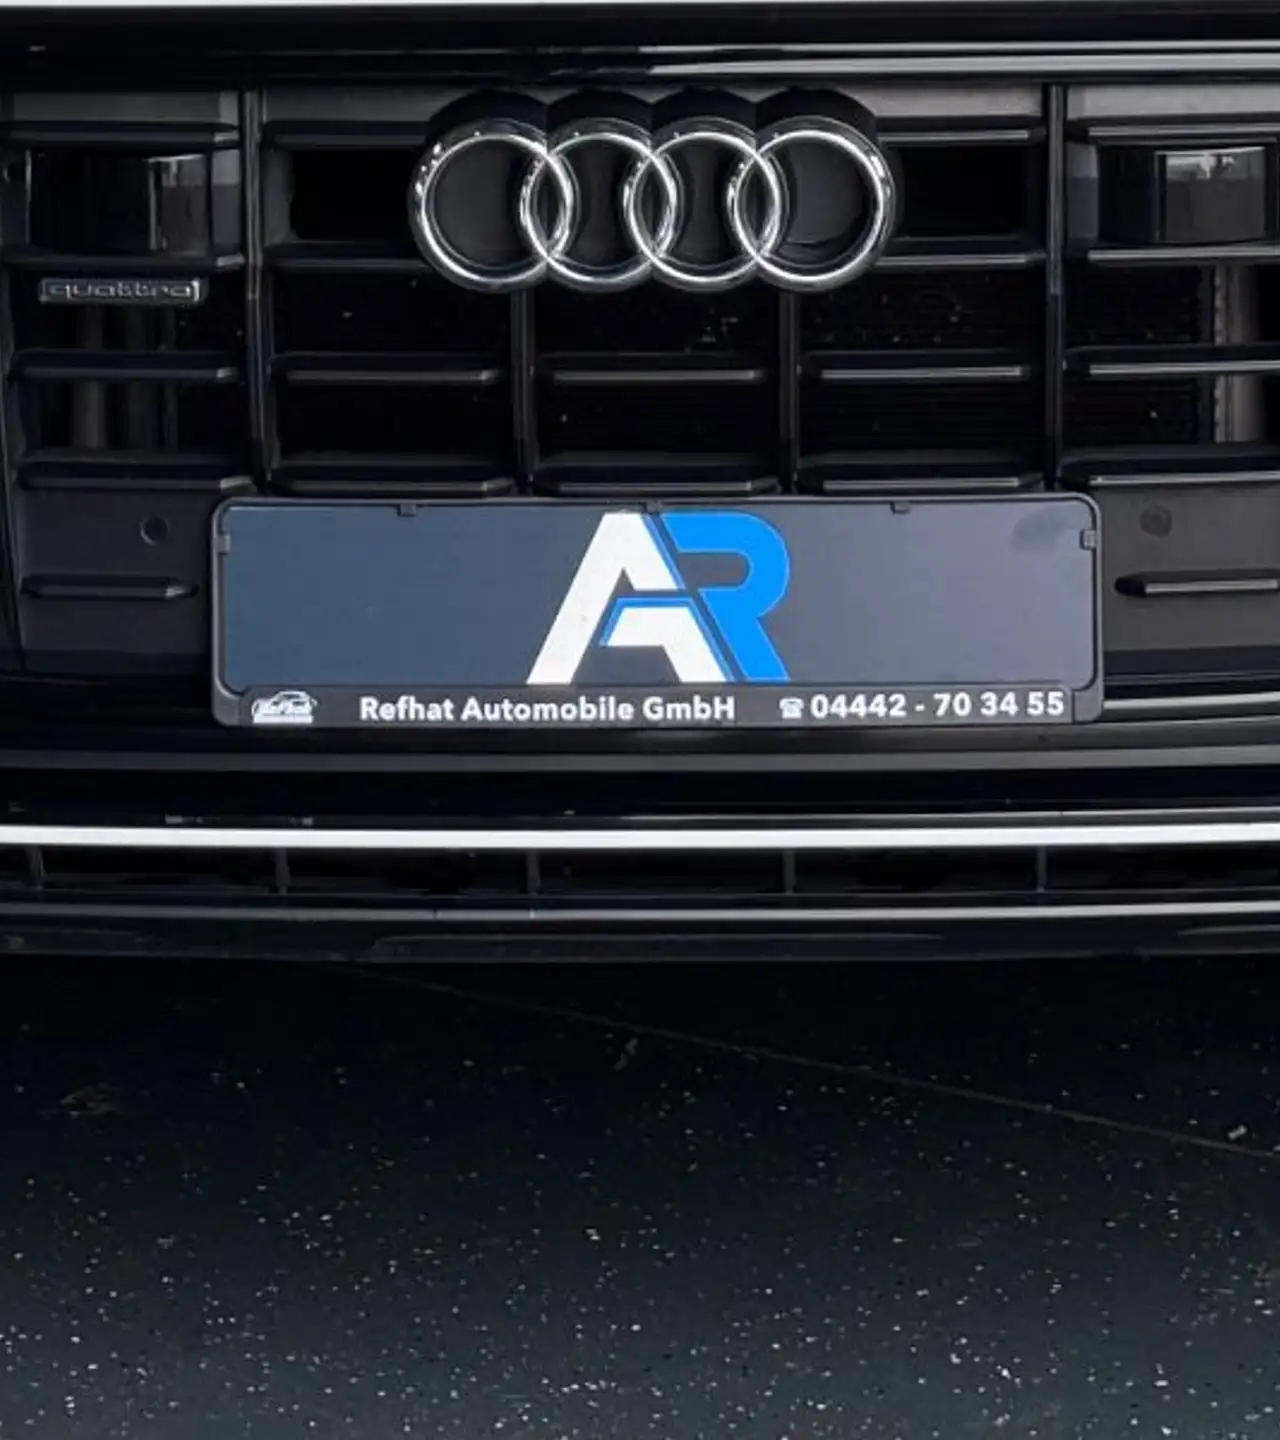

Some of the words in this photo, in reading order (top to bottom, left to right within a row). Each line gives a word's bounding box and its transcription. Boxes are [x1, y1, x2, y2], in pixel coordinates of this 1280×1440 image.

[48, 281, 192, 299] quattro
[526, 509, 791, 685] AR
[360, 695, 454, 721] Refhat
[460, 695, 634, 721] Automobile
[642, 694, 735, 721] GmbH
[810, 693, 907, 719] 04442
[933, 691, 972, 717] 70
[980, 691, 1019, 717] 34
[1027, 691, 1065, 716] 55
